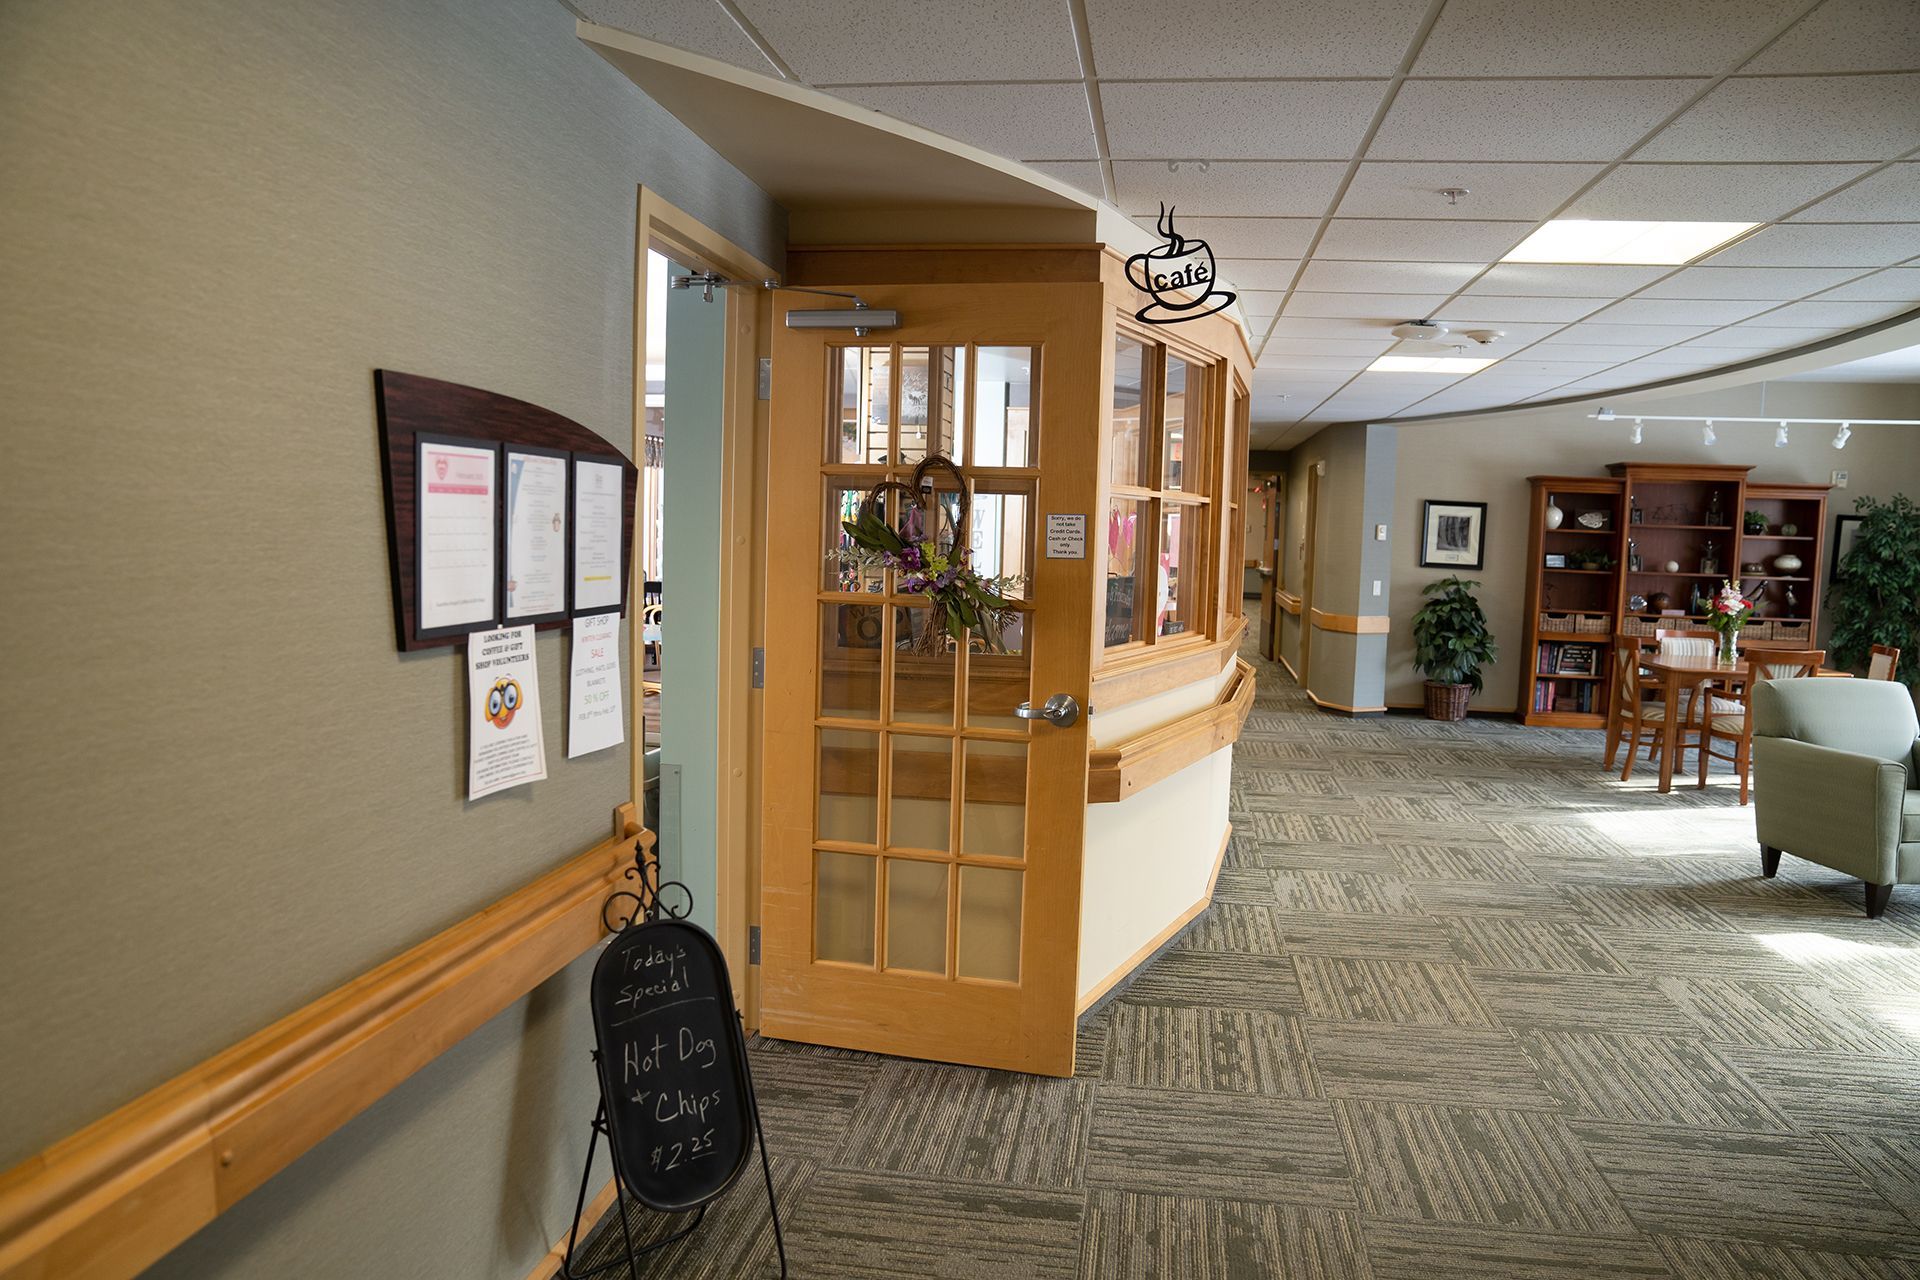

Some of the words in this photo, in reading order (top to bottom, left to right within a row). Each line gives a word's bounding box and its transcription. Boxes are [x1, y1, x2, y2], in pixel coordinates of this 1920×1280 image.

[1153, 261, 1209, 292] café
[597, 615, 609, 626] SHOP
[483, 632, 510, 643] LOOKING
[511, 630, 522, 639] FOR
[481, 645, 504, 656] COFFEE
[510, 642, 523, 651] GIFT
[591, 647, 604, 659] SALE
[475, 660, 491, 670] SHOP
[492, 653, 530, 667] VOLUNTEERS
[599, 690, 610, 702] OFF
[622, 944, 686, 977] Today's
[615, 966, 689, 1009] Special
[624, 1034, 669, 1084] Hot
[680, 1027, 716, 1068] Dog
[656, 1090, 720, 1123] Chips
[651, 1128, 717, 1172] $2.25
